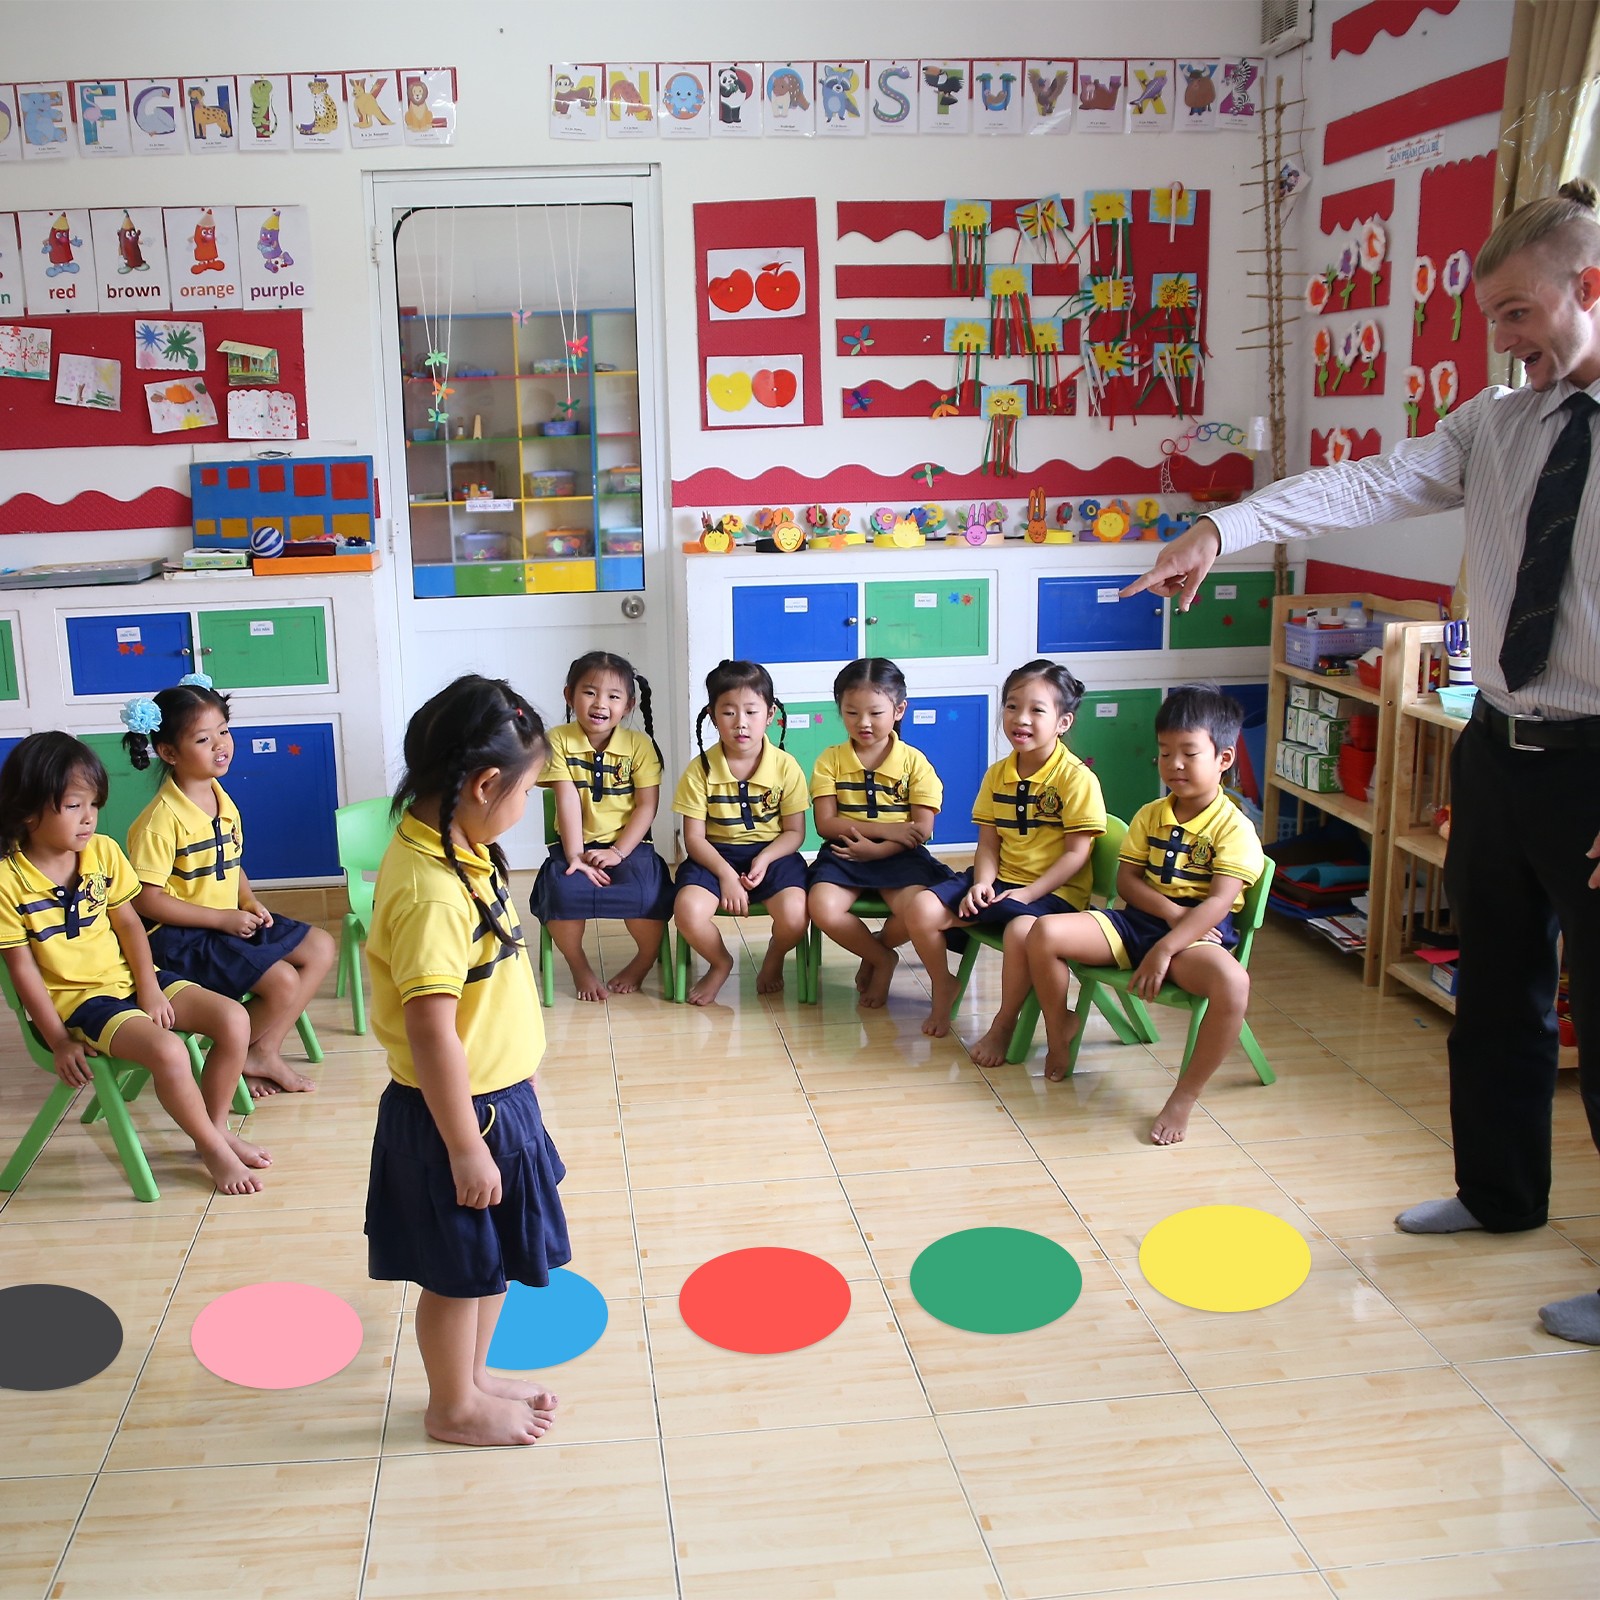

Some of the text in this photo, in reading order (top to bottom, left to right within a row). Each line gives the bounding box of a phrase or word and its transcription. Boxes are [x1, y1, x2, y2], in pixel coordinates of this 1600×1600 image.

[133, 86, 175, 136] G
[189, 85, 233, 139] H
[350, 78, 395, 127] K
[405, 77, 448, 130] L
[609, 71, 652, 121] N
[873, 66, 911, 123] S
[1131, 70, 1168, 114] X
[1219, 62, 1258, 116] Z
[80, 85, 116, 145] F
[49, 284, 76, 299] red
[106, 284, 161, 299] brown
[180, 282, 235, 299] orange
[250, 281, 305, 301] purple
